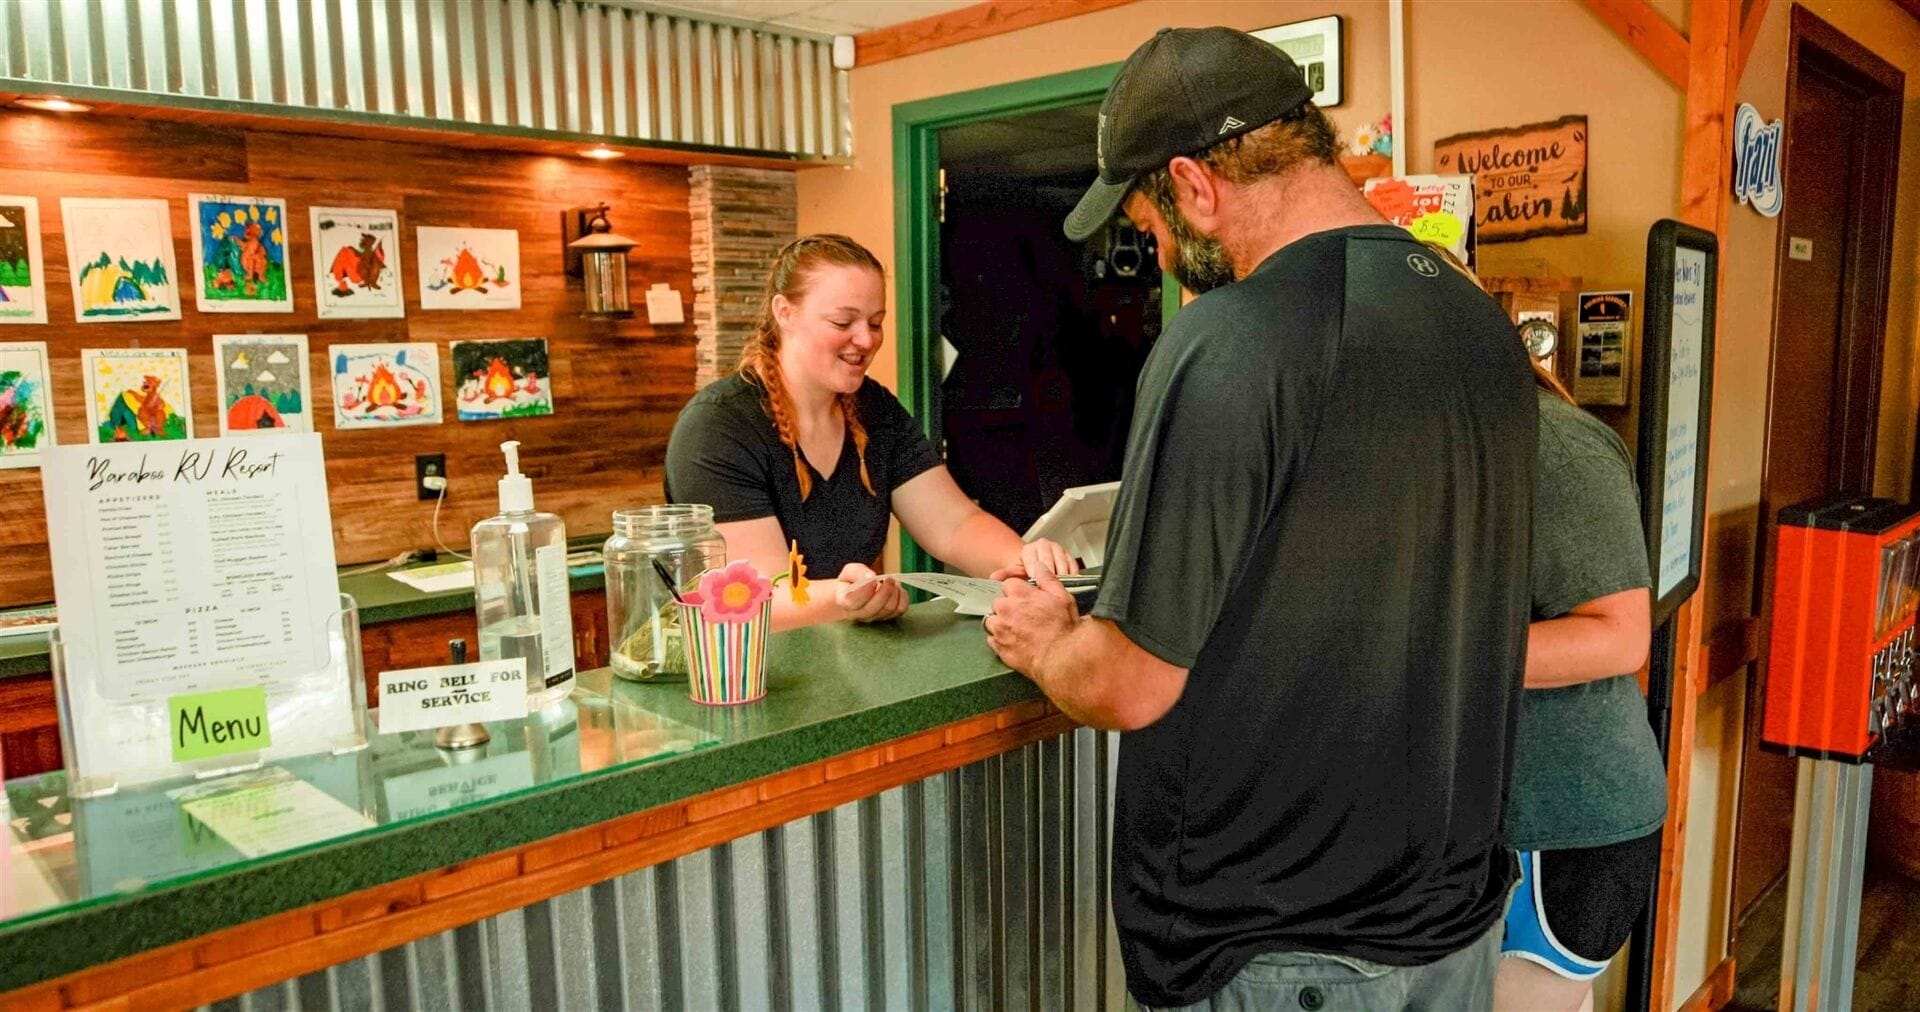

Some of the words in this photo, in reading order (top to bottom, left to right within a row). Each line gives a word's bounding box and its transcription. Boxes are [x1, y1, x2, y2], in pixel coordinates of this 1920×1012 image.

[1458, 141, 1566, 174] Welcome
[1738, 118, 1780, 198] frazil
[1490, 176, 1504, 189] TO
[1508, 174, 1531, 187] OUR
[1442, 183, 1461, 216] PIZZ
[1477, 193, 1554, 227] abin
[87, 454, 164, 491] Baraboo
[173, 449, 215, 484] RV
[221, 446, 285, 481] Resort
[185, 605, 218, 615] PIZZA
[386, 680, 429, 695] RING
[440, 674, 479, 688] BELL
[490, 670, 522, 683] FOR
[421, 691, 491, 709] SERVICE
[179, 705, 261, 748] Menu
